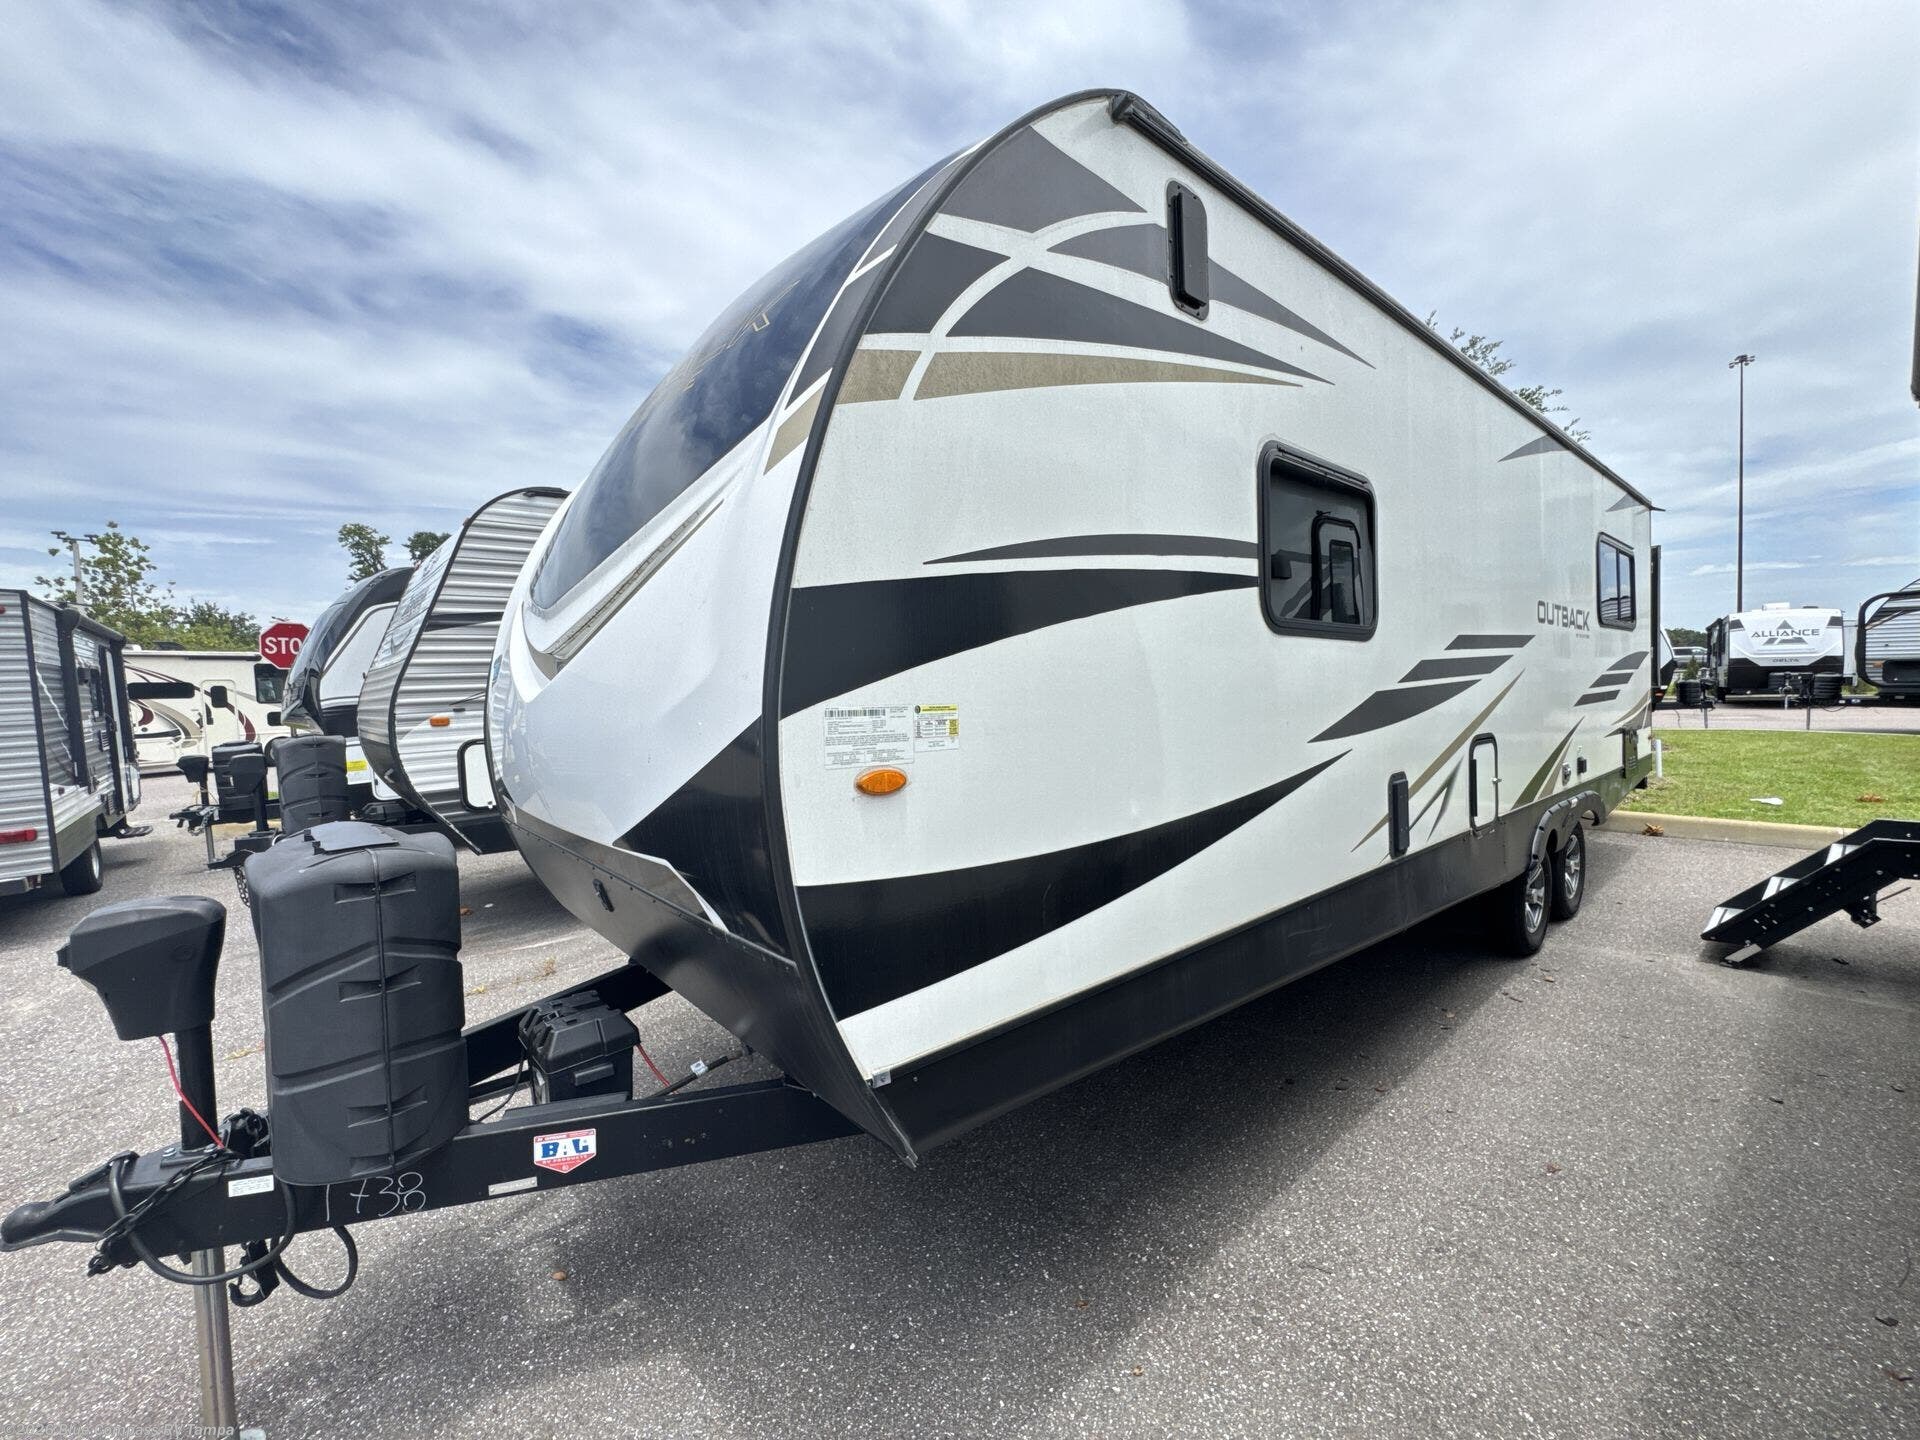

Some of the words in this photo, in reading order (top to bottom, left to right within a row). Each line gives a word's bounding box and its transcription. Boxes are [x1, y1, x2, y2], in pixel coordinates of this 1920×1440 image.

[1537, 599, 1590, 632] OUTBACK
[1751, 628, 1820, 638] ALLIANCE
[264, 636, 303, 655] STO
